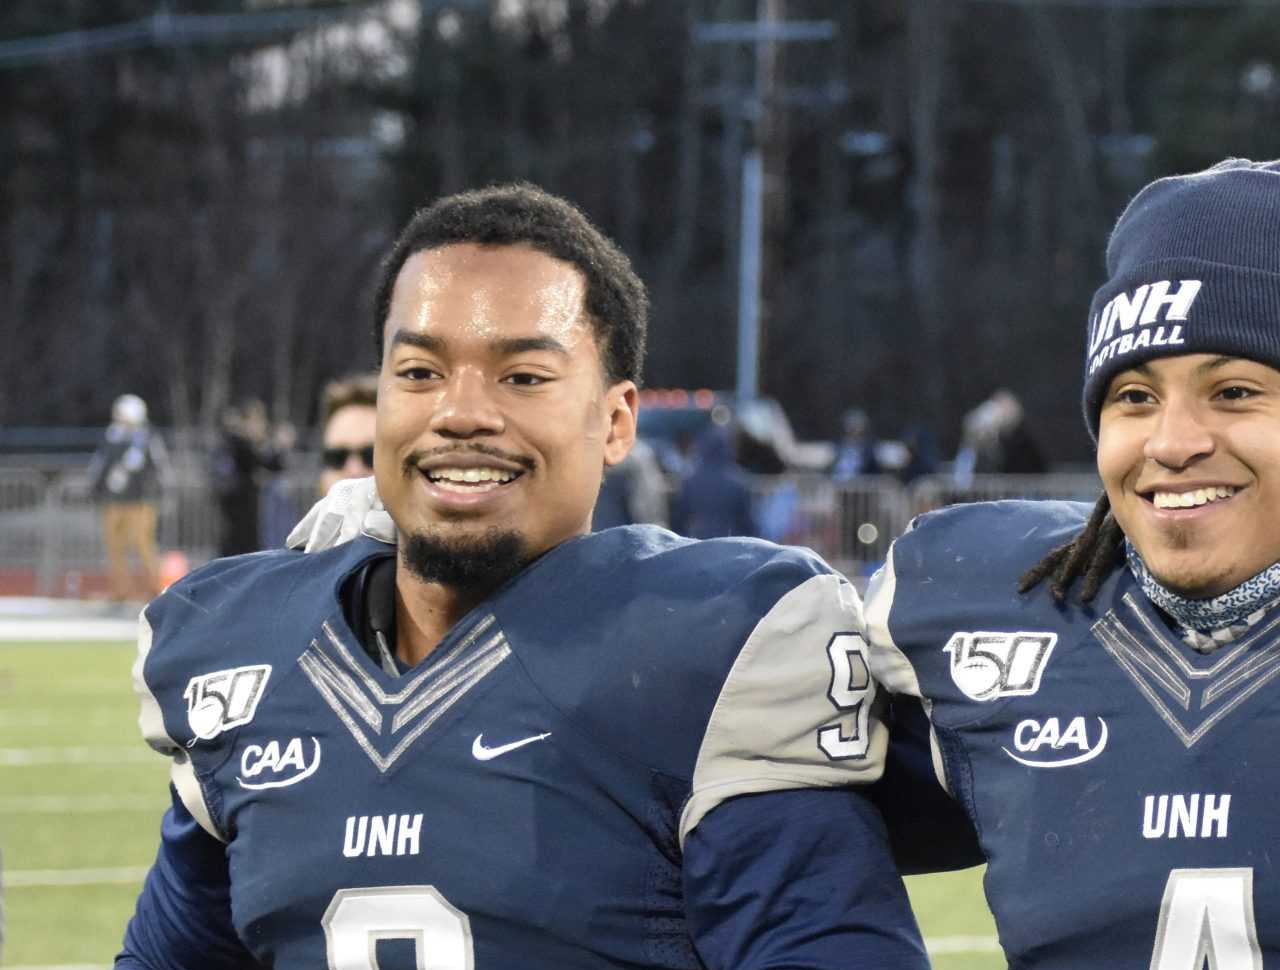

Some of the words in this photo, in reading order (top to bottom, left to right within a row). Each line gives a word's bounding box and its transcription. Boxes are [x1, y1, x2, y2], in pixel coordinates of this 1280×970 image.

[1089, 280, 1202, 359] UNH
[1089, 325, 1184, 375] OOTBALL
[943, 631, 1058, 701] 150
[183, 664, 272, 740] 150
[817, 631, 876, 761] 9
[241, 738, 306, 777] CAA
[1014, 716, 1088, 752] CAA
[343, 813, 424, 857] UNH
[1143, 793, 1231, 839] UNH
